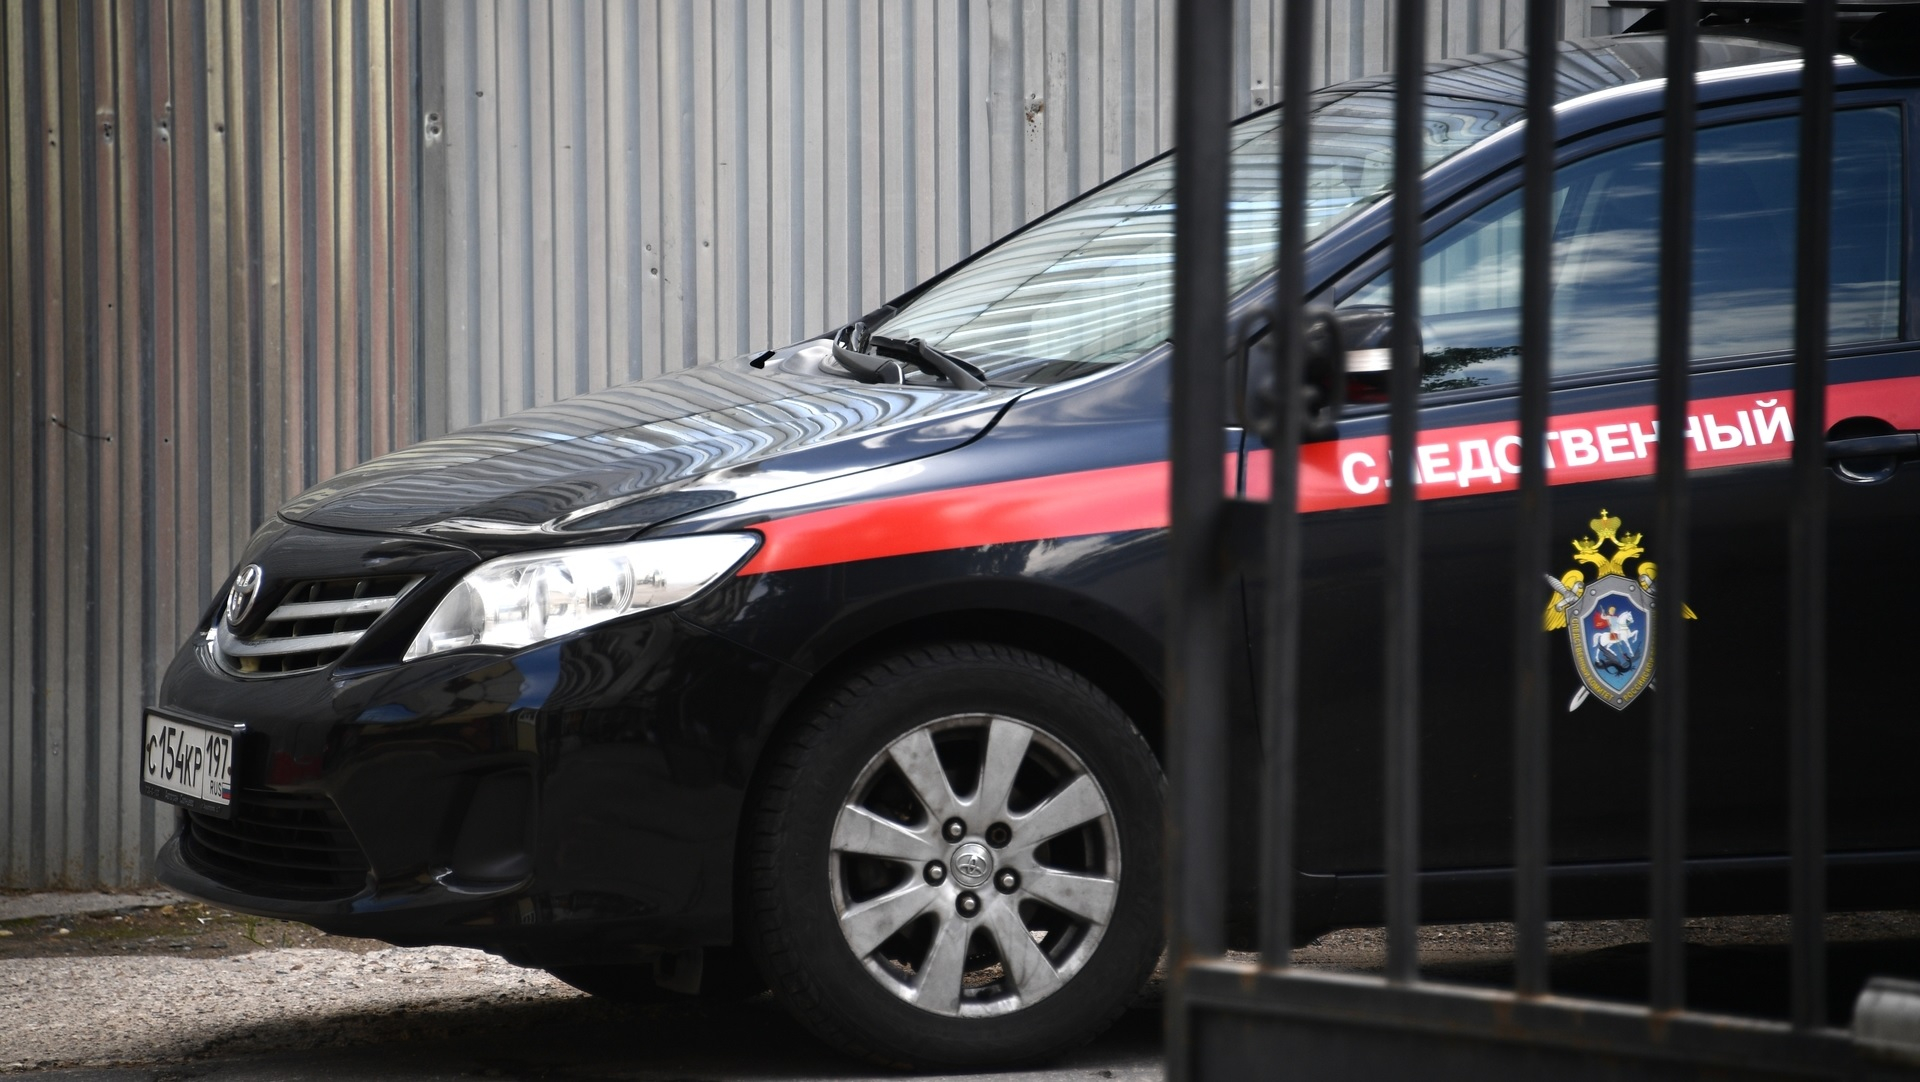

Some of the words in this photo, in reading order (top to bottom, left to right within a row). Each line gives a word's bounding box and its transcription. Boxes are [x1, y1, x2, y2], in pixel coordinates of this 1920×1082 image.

[1588, 675, 1614, 700] КОМИТЕТ
[148, 725, 202, 787] С154КР
[206, 734, 229, 780] 197
[210, 780, 222, 797] RUS
